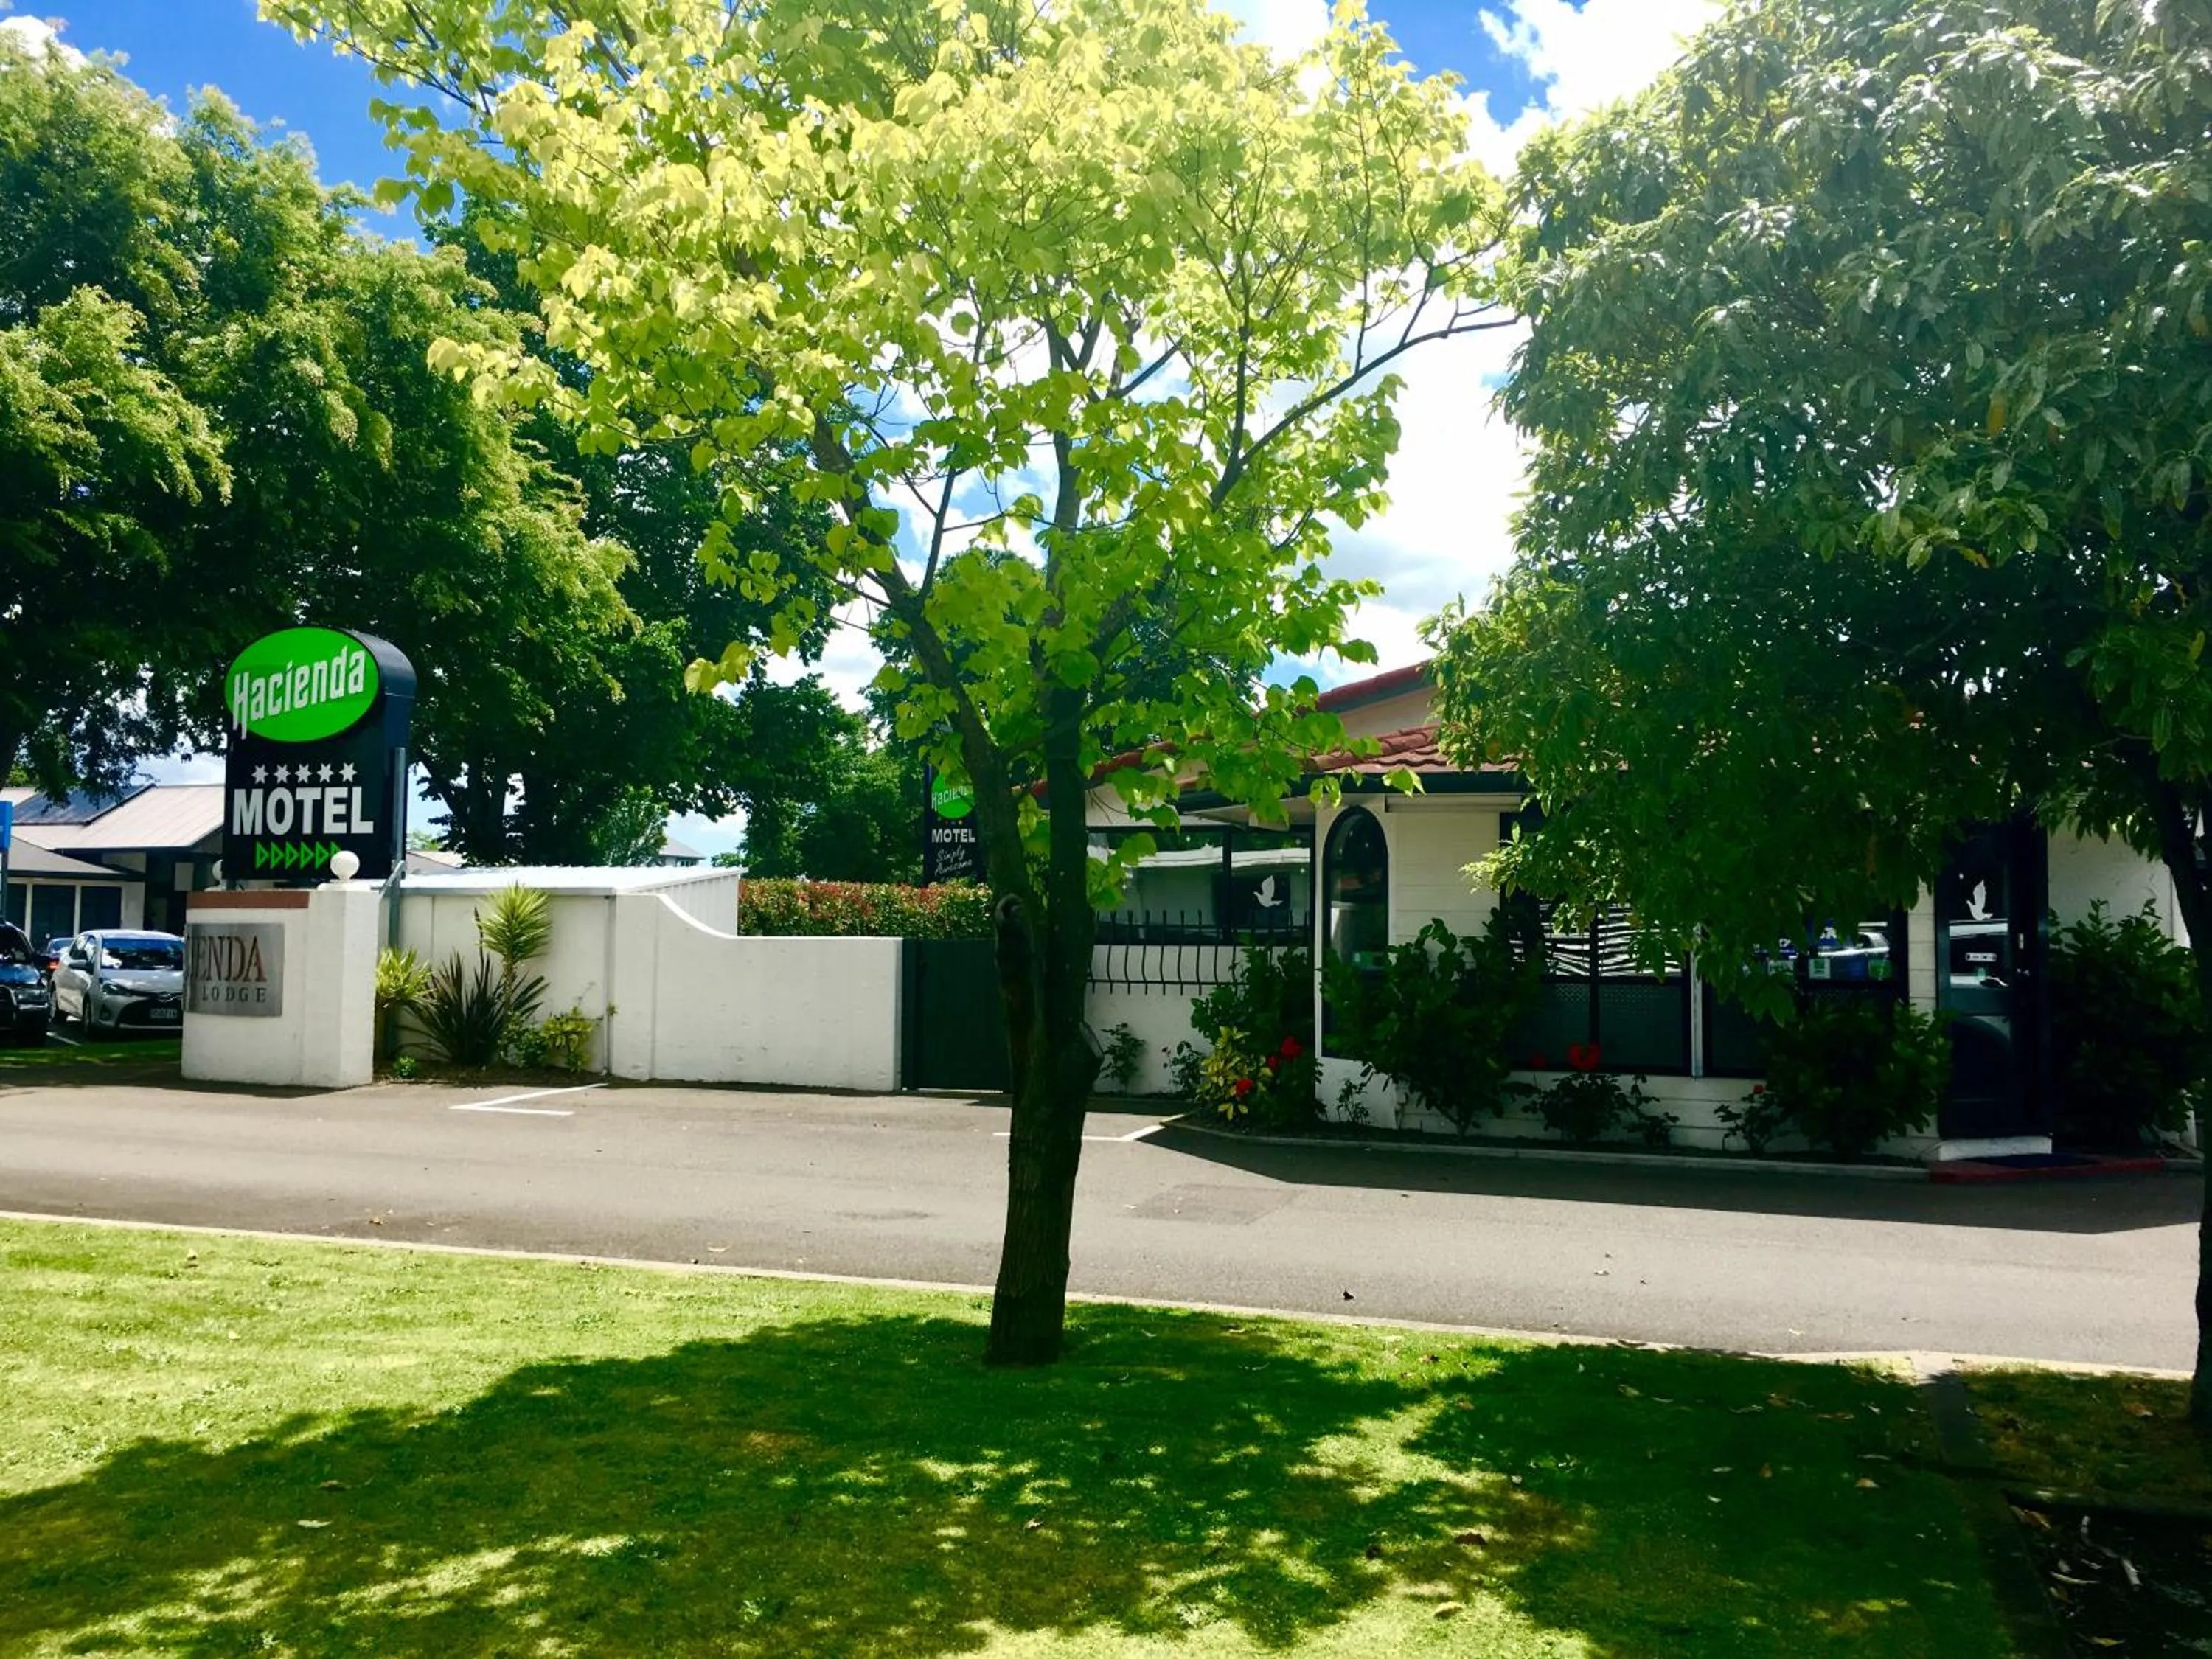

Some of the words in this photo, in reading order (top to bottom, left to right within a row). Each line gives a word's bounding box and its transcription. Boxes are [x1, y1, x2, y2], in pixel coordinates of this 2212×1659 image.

[232, 644, 367, 740] Hacienda
[232, 786, 375, 836] MOTEL
[931, 828, 975, 843] MOTEL
[201, 985, 267, 1003] LODGE
